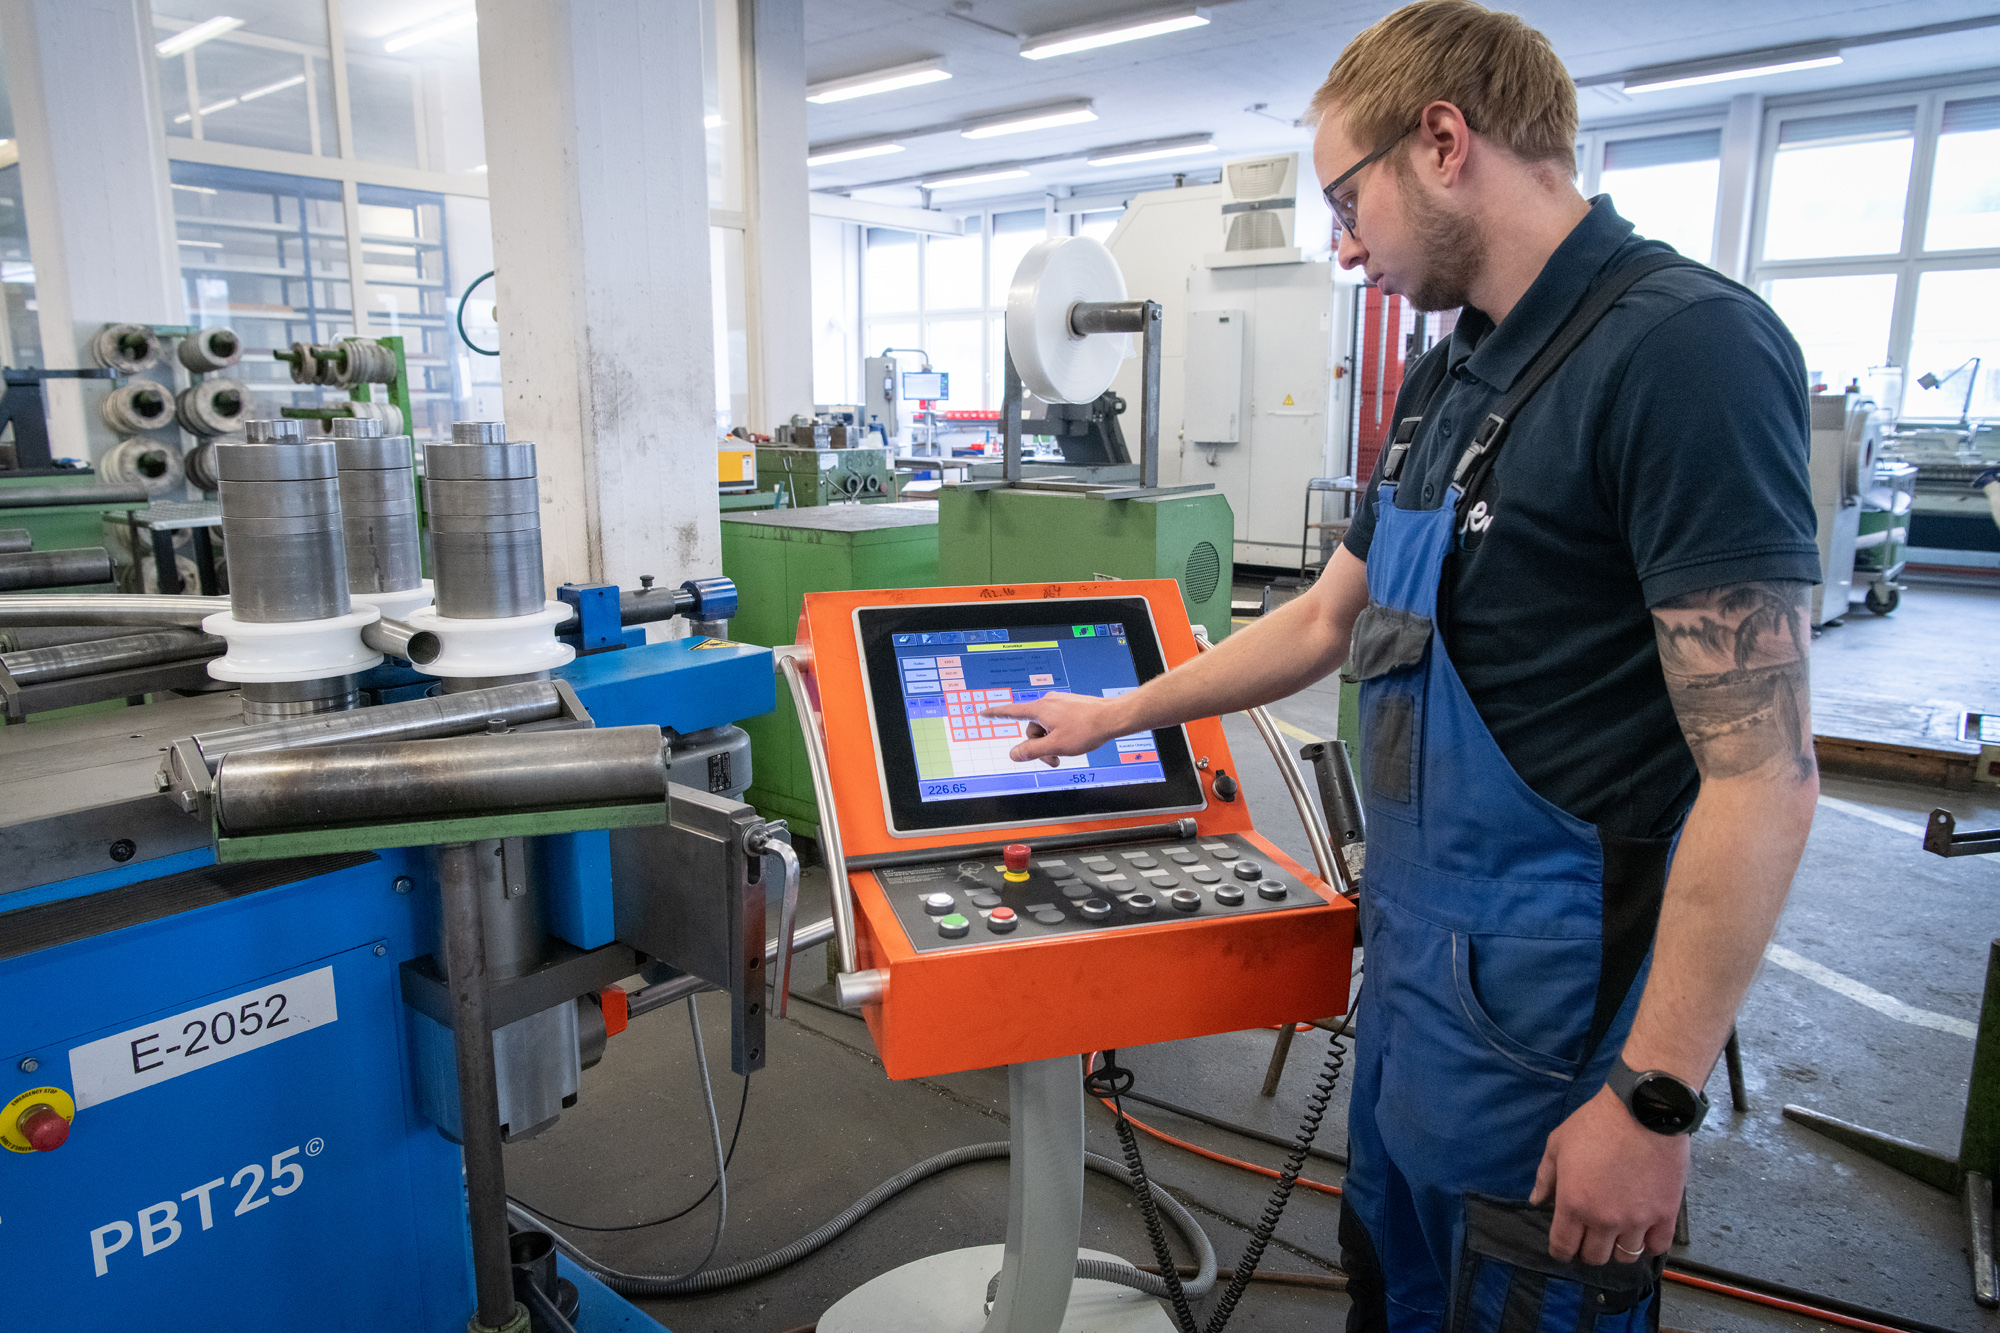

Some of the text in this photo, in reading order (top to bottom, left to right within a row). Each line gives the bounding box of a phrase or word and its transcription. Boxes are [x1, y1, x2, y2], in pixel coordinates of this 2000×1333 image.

[1069, 773, 1096, 784] -58.7
[928, 783, 967, 795] 226.65
[131, 994, 289, 1074] E-2052
[11, 1089, 43, 1106] EMERGENCY
